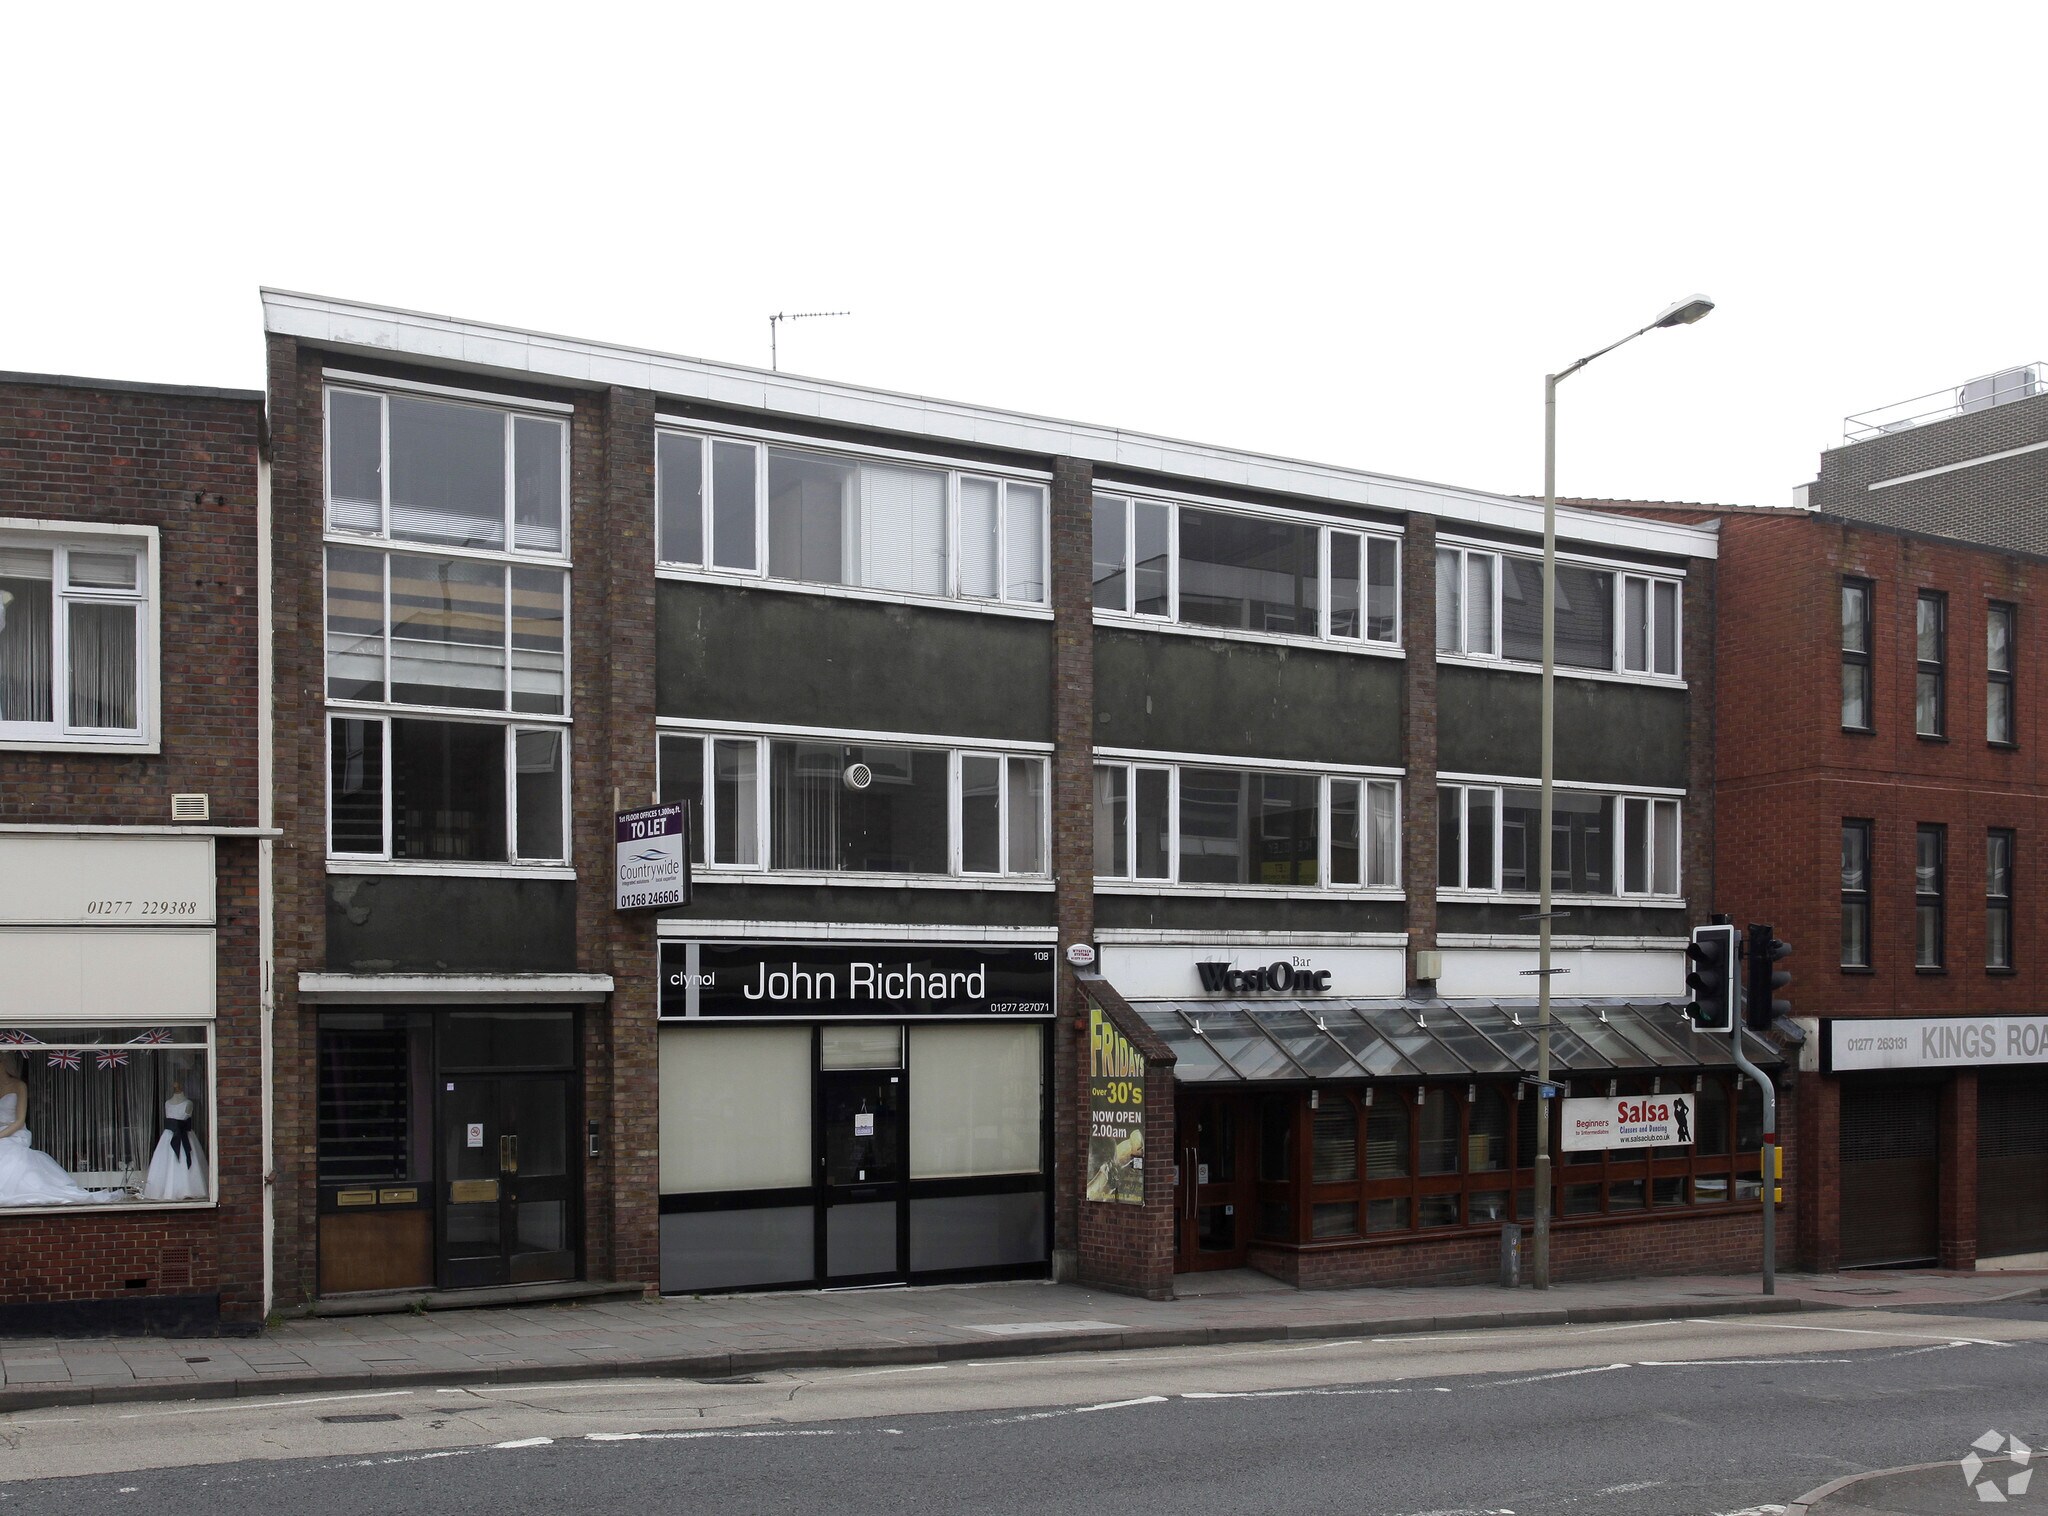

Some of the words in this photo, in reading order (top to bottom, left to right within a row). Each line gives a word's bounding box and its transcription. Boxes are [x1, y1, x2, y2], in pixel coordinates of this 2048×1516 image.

[626, 813, 640, 822] FLOOR
[640, 810, 658, 819] OFFICES
[631, 820, 646, 838] TO
[648, 818, 666, 836] LET
[620, 860, 680, 880] Countrywide
[622, 893, 646, 907] 01268
[648, 890, 679, 904] 246606
[87, 900, 133, 914] 01277
[141, 901, 197, 914] 229388
[1034, 952, 1049, 960] 108
[1292, 956, 1312, 966] Bar
[670, 971, 715, 990] clynol
[743, 962, 836, 1000] John
[850, 962, 985, 999] Richard
[990, 1003, 1017, 1012] 01277
[1018, 1002, 1049, 1012] 227071
[1090, 1009, 1145, 1078] FRIDAYS
[1848, 1038, 1874, 1052] 01277
[1877, 1037, 1908, 1050] 263131
[1922, 1024, 1996, 1059] KINGS
[1092, 1087, 1107, 1096] Over
[1107, 1082, 1143, 1104] 30's
[1092, 1110, 1114, 1122] NOW
[1116, 1111, 1142, 1123] OPEN
[1618, 1100, 1669, 1124] Salsa
[1092, 1124, 1127, 1138] 2.00am
[1576, 1119, 1610, 1130] Beginners
[1620, 1126, 1638, 1134] Classes
[1639, 1124, 1648, 1132] and
[1649, 1124, 1668, 1134] Dancing
